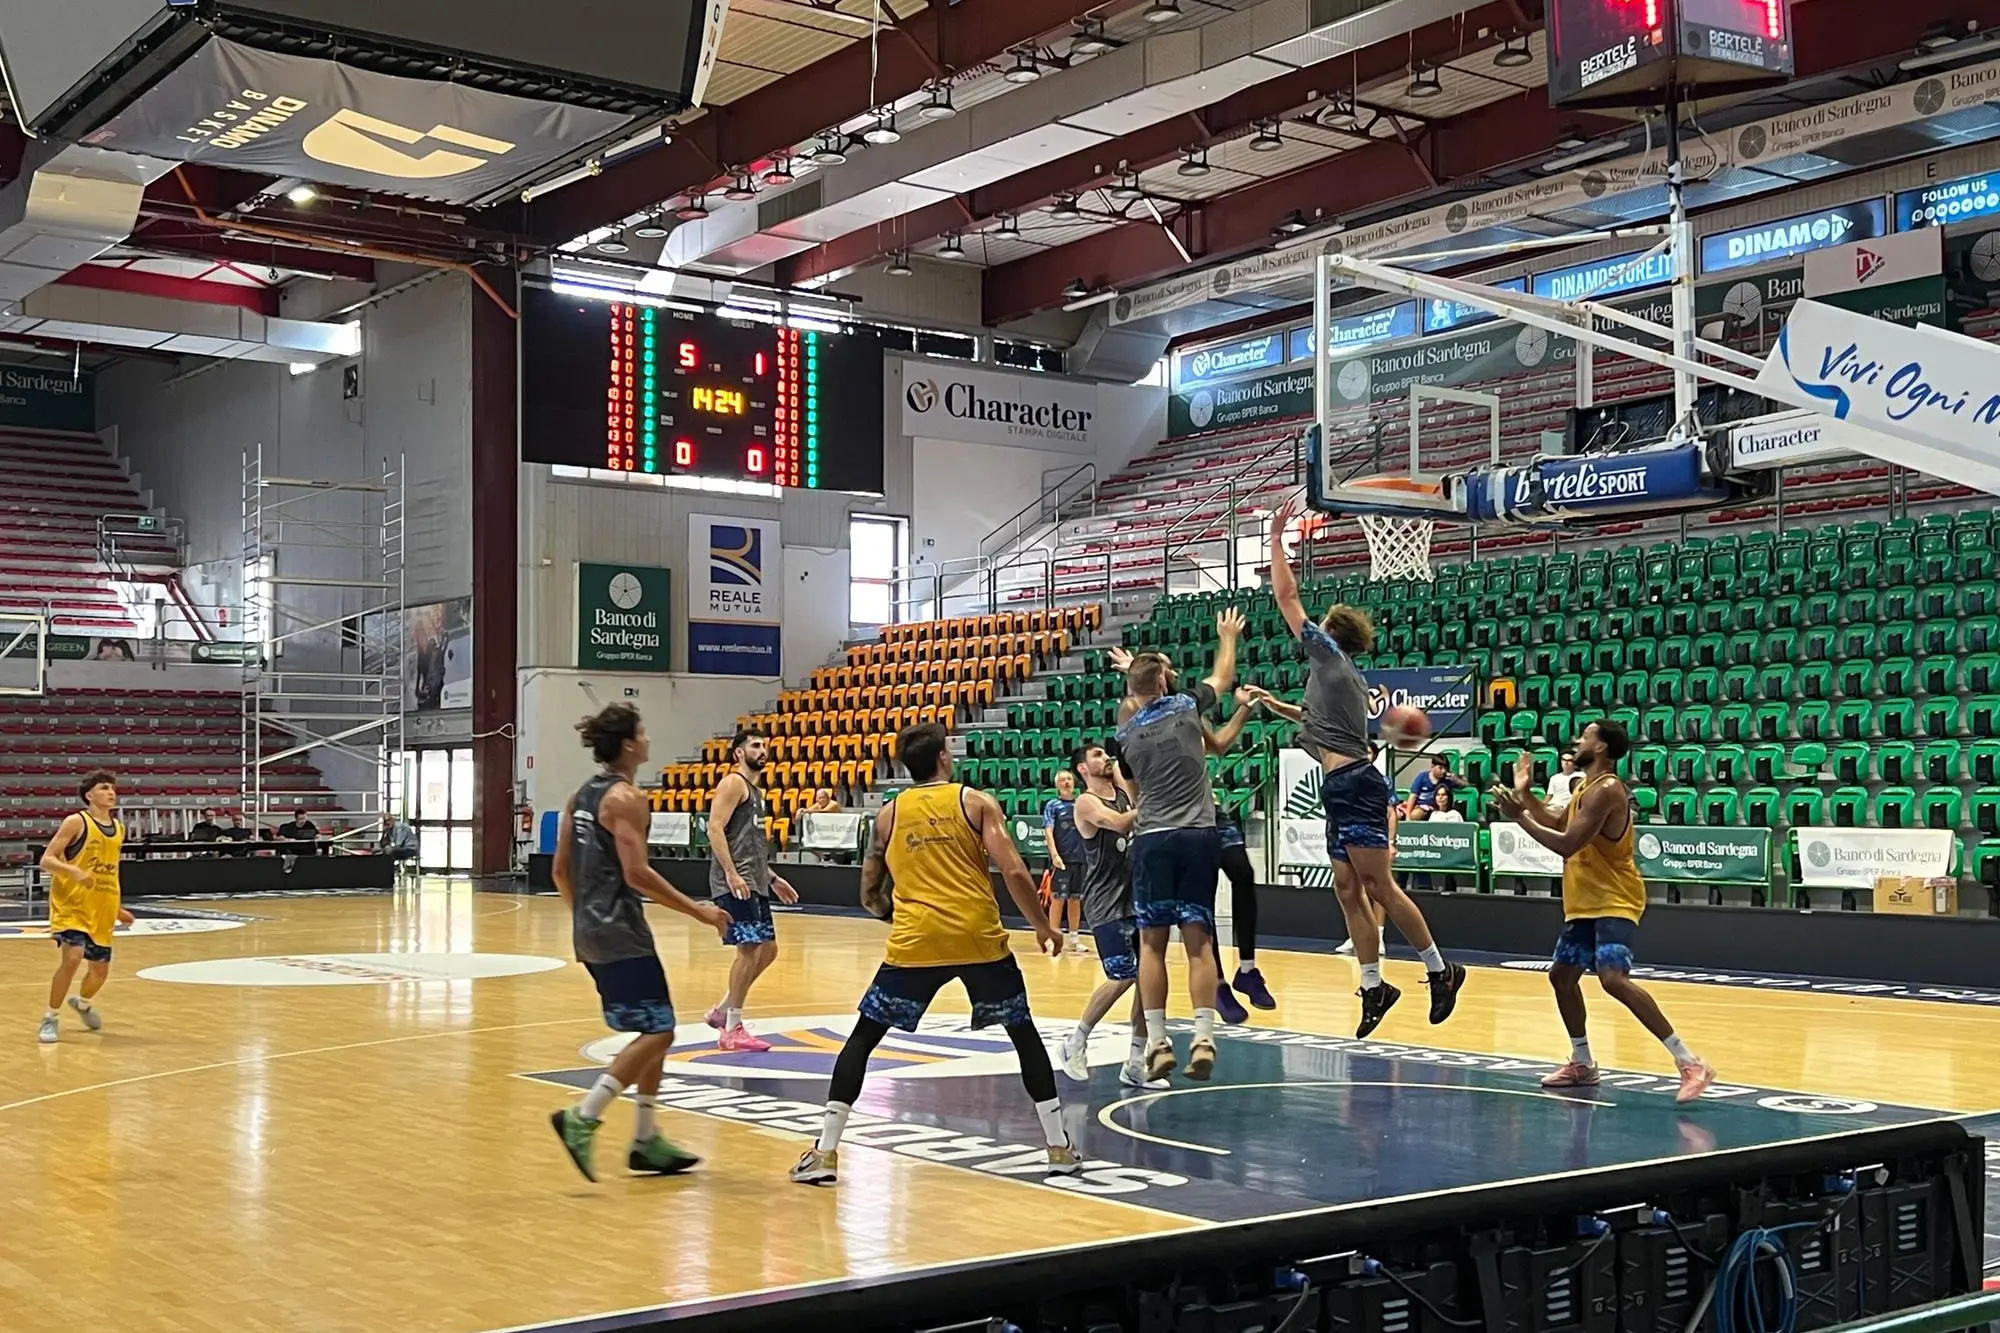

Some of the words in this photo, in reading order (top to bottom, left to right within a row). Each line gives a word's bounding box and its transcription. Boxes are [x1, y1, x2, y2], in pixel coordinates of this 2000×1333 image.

[1950, 69, 1997, 90] Banco
[1952, 92, 1984, 107] Gruppo
[176, 89, 268, 143] BASKET
[209, 96, 308, 149] DINAMO
[1771, 114, 1810, 136] Banco
[1810, 108, 1826, 125] di
[1827, 93, 1891, 121] Sardegna
[1771, 139, 1801, 153] Gruppo
[1927, 163, 1936, 177] E
[1471, 196, 1502, 213] Banco
[1514, 180, 1564, 203] Sardegna
[1922, 184, 1968, 204] FOLLOW
[1971, 180, 1988, 193] US
[1346, 231, 1374, 247] Banco
[1385, 215, 1430, 236] Sardegna
[1856, 254, 1879, 271] TV
[673, 311, 694, 320] HOME
[1882, 302, 1941, 321] Sardegna
[611, 346, 620, 358] 7
[680, 343, 695, 367] 5
[1210, 347, 1266, 369] Character
[1372, 357, 1411, 375] Banco
[1413, 352, 1424, 364] di
[1427, 340, 1490, 366] Sardegna
[755, 352, 763, 375] 1
[6, 371, 83, 395] Sardegna
[1217, 387, 1250, 406] Banco
[1252, 383, 1262, 398] di
[1263, 375, 1315, 396] Sardegna
[1372, 382, 1400, 395] Gruppo
[1421, 372, 1444, 385] Banca
[1819, 343, 1883, 384] Vivi
[1885, 362, 1969, 421] Ogni
[944, 382, 1092, 432] Character
[1217, 411, 1241, 423] Gruppo
[1259, 404, 1278, 416] Banca
[1007, 425, 1043, 438] STAMPA
[1046, 430, 1087, 442] DIGITALE
[1738, 428, 1821, 455] Character
[676, 441, 691, 465] 0
[747, 449, 762, 472] 0
[1514, 464, 1596, 503] brtelè
[1599, 471, 1646, 495] SPORT
[710, 590, 761, 604] REALE
[595, 609, 641, 627] Banco
[643, 611, 656, 628] di
[710, 603, 761, 614] MUTUA
[46, 642, 85, 652] GREEN
[590, 628, 660, 650] Sardegna
[698, 643, 772, 655] www.realemutua.it
[596, 651, 620, 662] Gruppo
[1420, 834, 1428, 847] di
[1429, 834, 1470, 850] Sardegna
[1662, 840, 1694, 855] Banco
[1695, 840, 1706, 855] di
[1707, 841, 1758, 859] Sardegna
[1663, 858, 1686, 869] Gruppo
[1703, 860, 1722, 869] Banca
[1835, 847, 1872, 861] Banco
[1875, 848, 1884, 861] di
[1886, 849, 1941, 864] Sardegna
